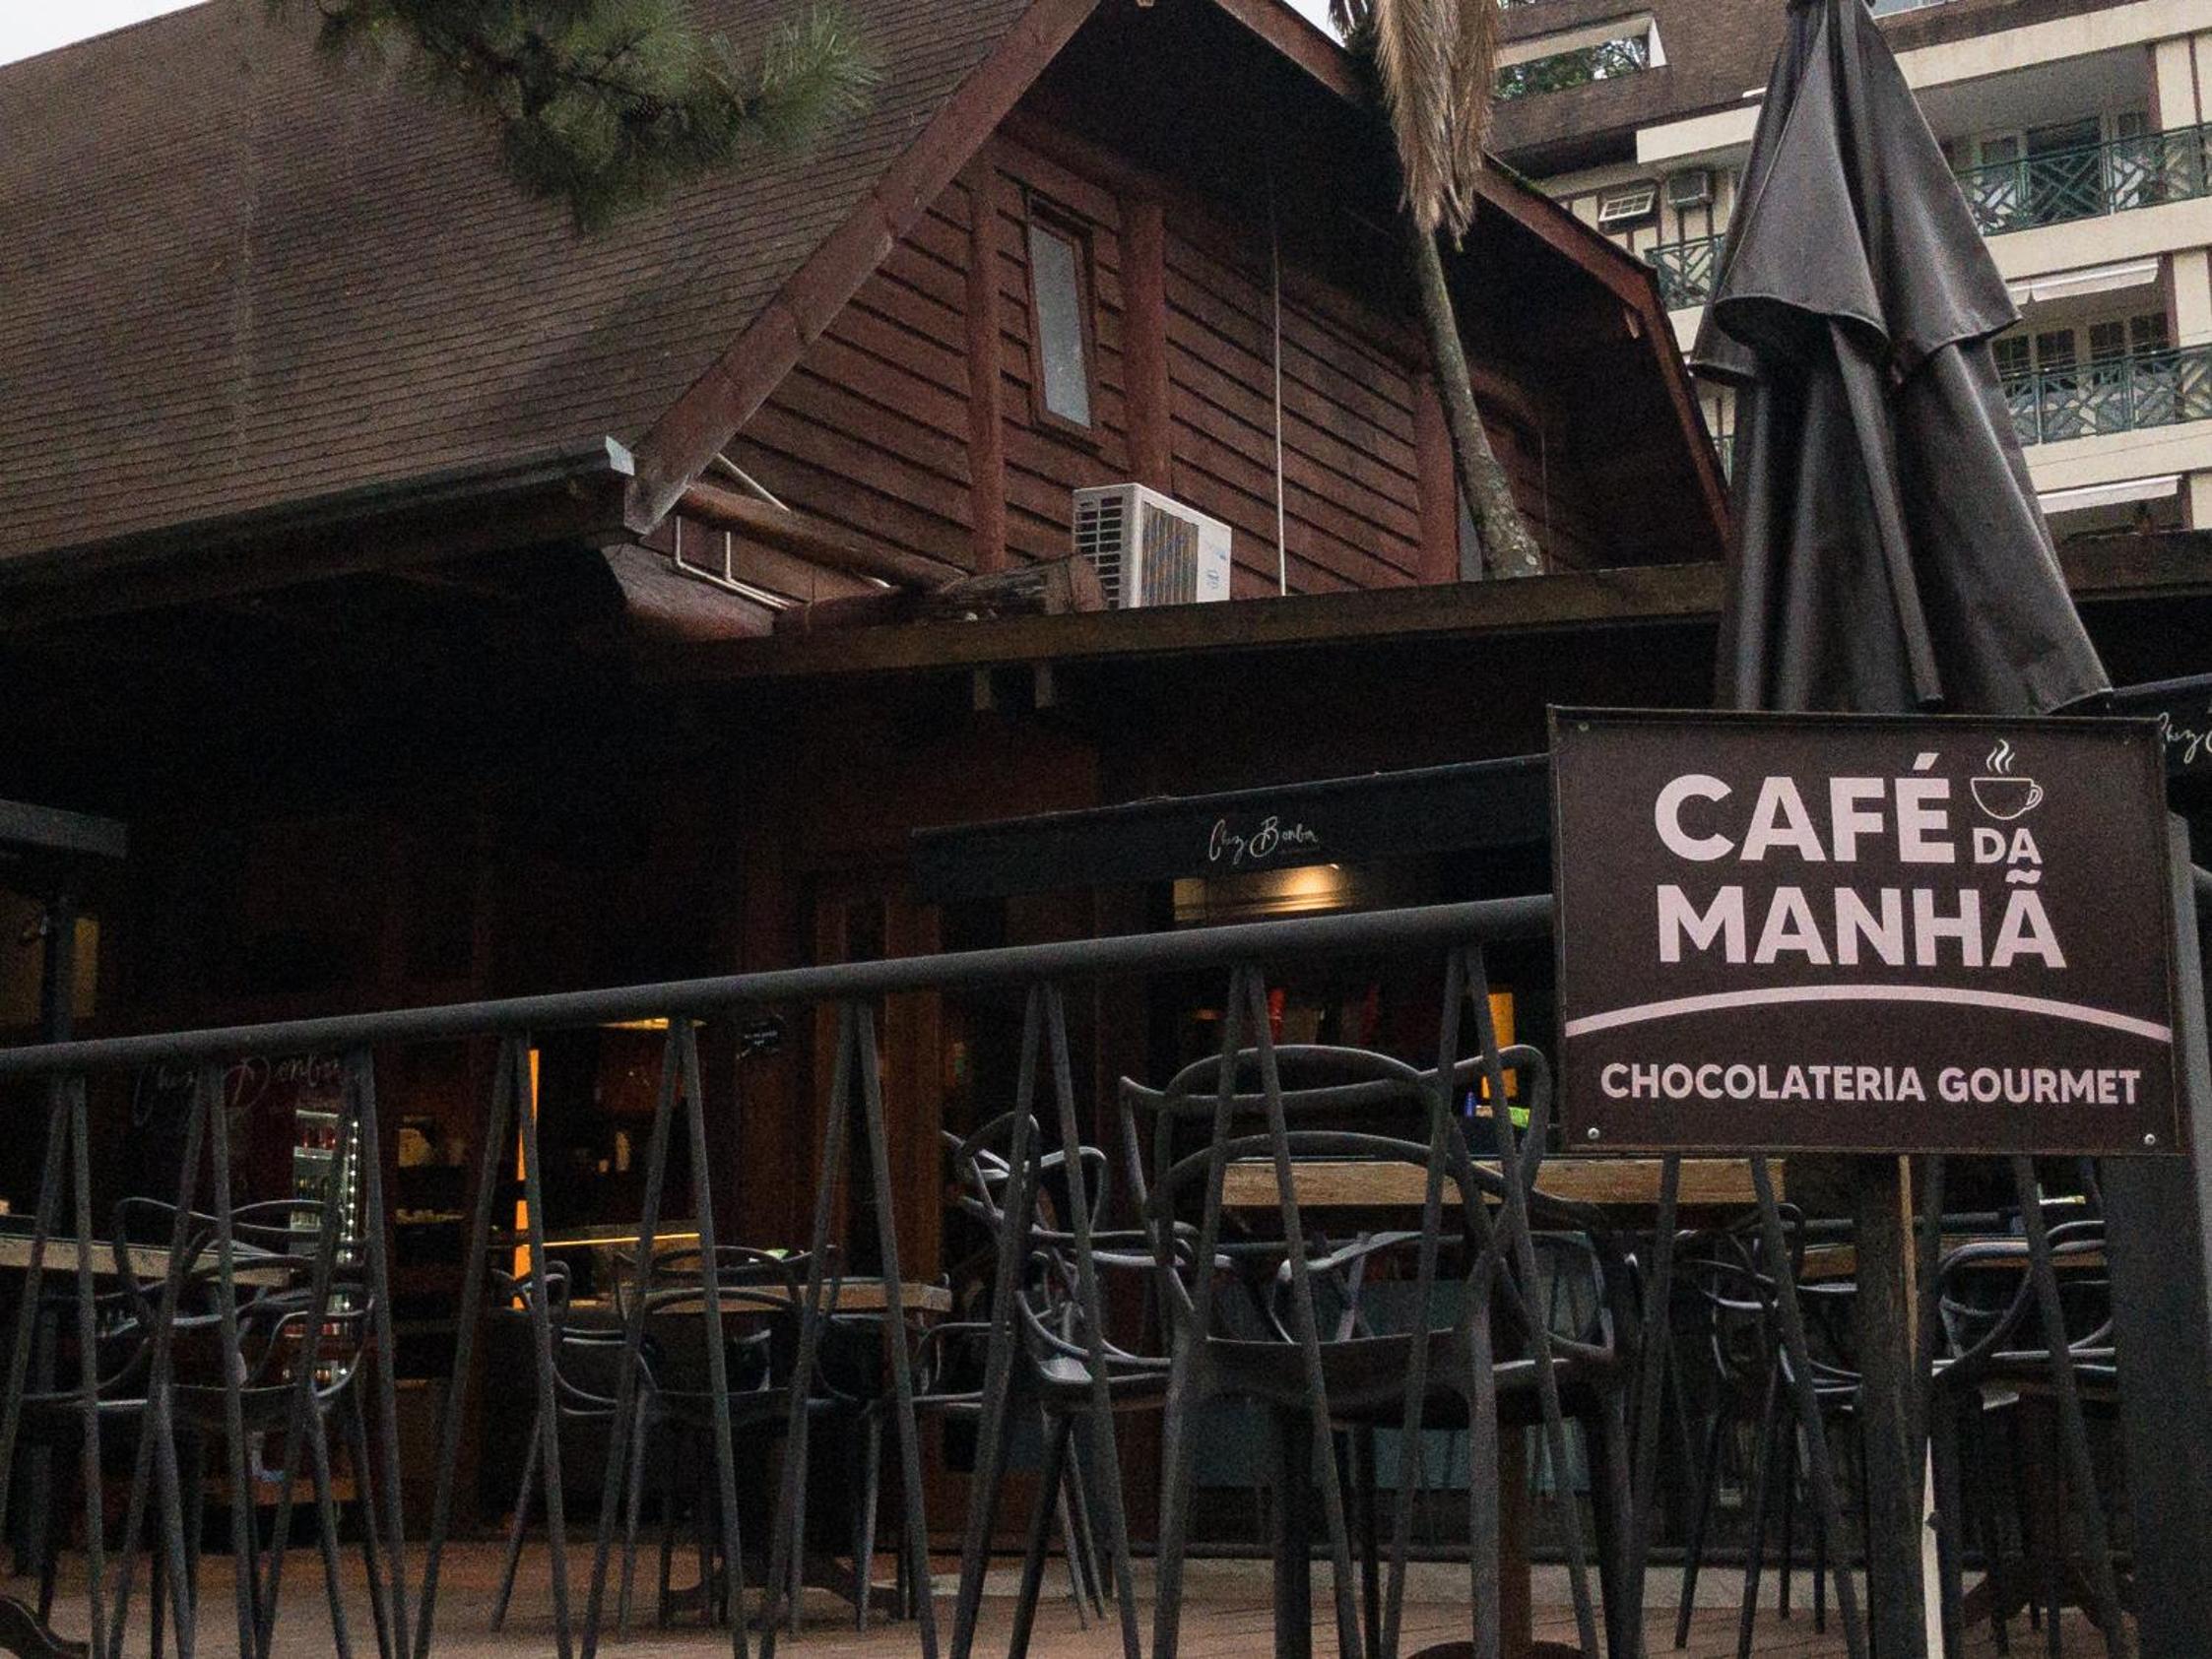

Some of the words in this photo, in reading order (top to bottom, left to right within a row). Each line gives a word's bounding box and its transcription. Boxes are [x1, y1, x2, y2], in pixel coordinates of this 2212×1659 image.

[1655, 753, 1957, 864] CAFÉ
[1974, 828, 2044, 865] DA
[1658, 869, 2068, 969] MANHÃ
[1601, 1063, 1927, 1103] CHOCOLATERIA
[1938, 1067, 2142, 1106] GOURMET
